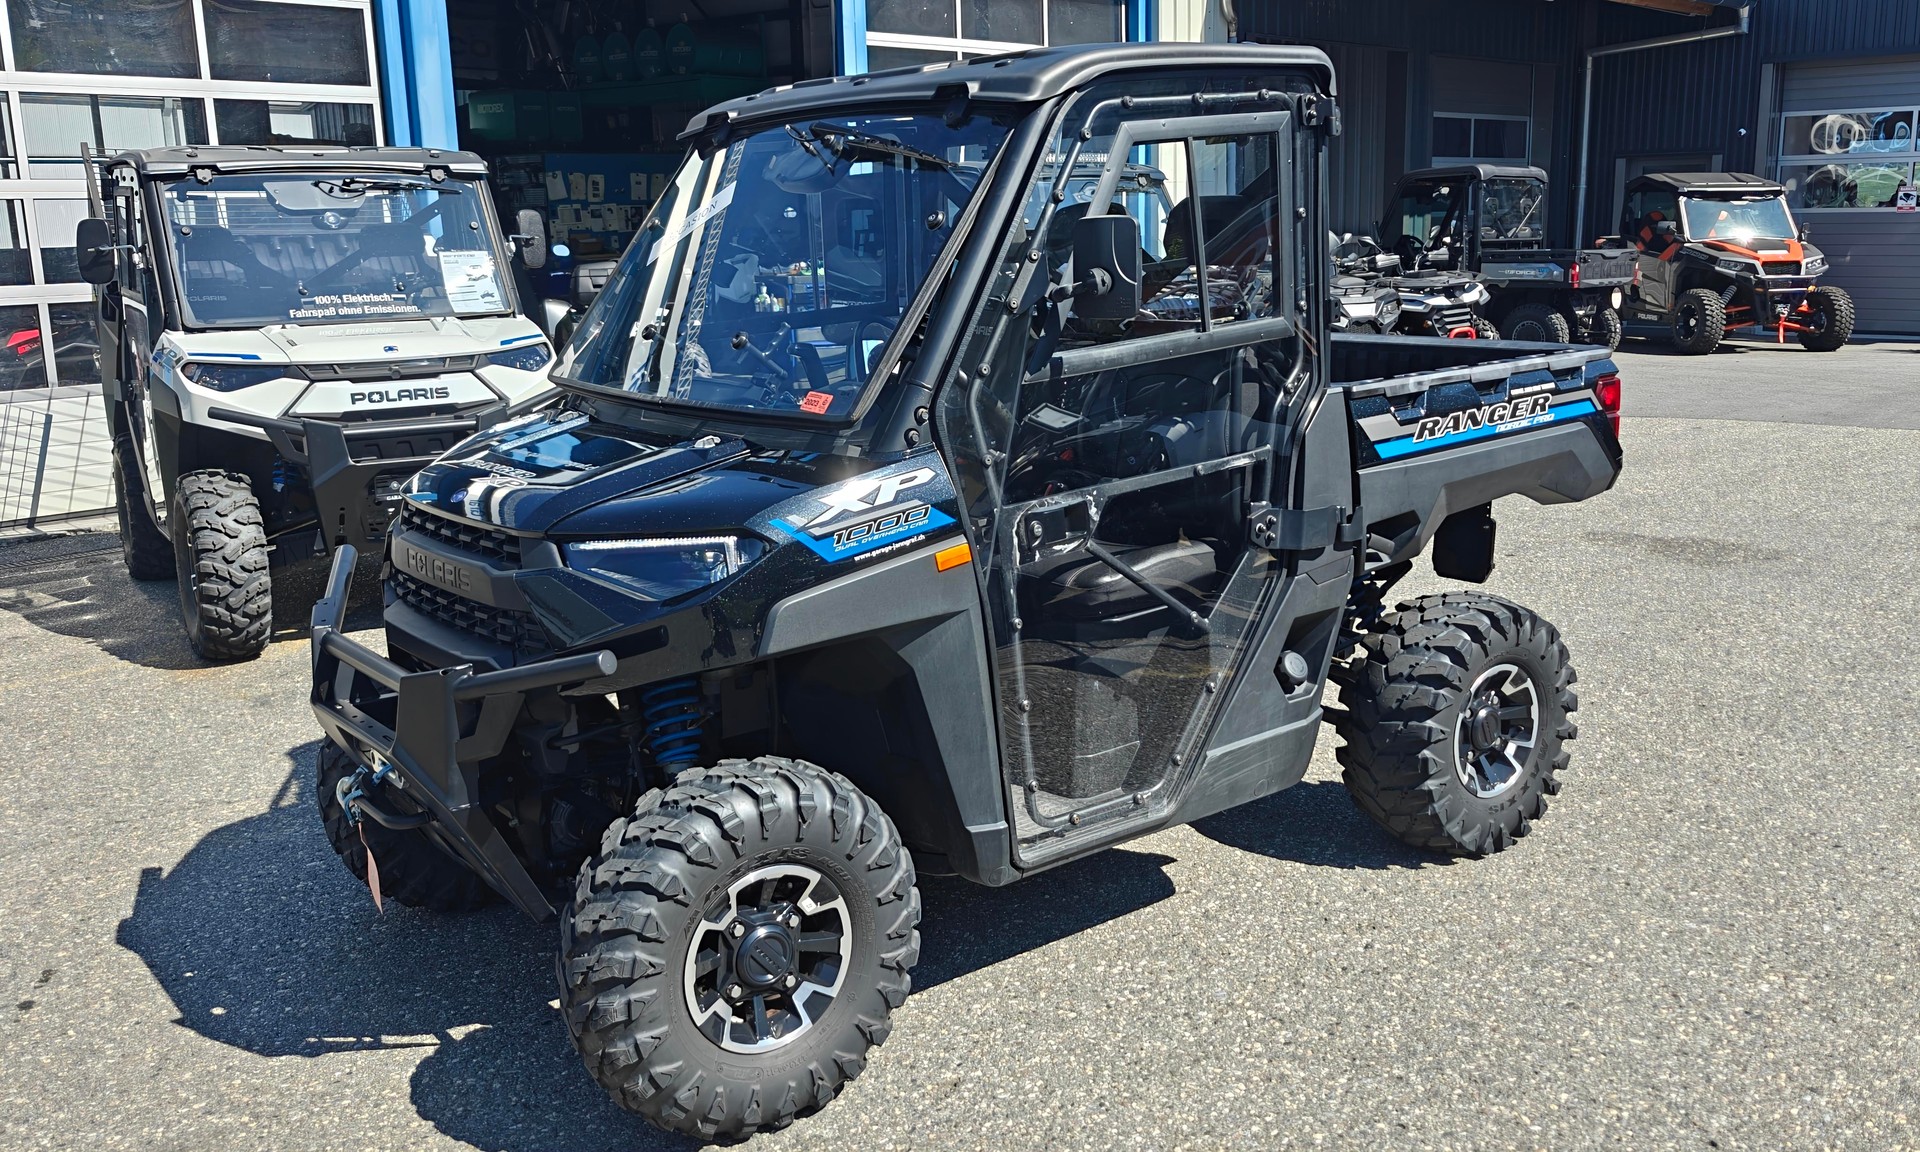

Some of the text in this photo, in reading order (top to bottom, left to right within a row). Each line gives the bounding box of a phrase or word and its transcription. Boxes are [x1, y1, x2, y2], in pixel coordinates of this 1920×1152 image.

[313, 292, 394, 305] 100% Elektrisch.
[338, 305, 362, 316] ohne
[364, 303, 421, 315] Emissionen.
[350, 386, 450, 405] POLARIS
[804, 398, 820, 407] 2023
[1412, 393, 1553, 443] RANGER
[1495, 413, 1555, 433] NORDIC PRO
[804, 466, 938, 528] XP
[832, 504, 932, 548] 1000
[834, 518, 930, 553] DUAL OVERHEAD CAM
[406, 547, 472, 592] POLARIS
